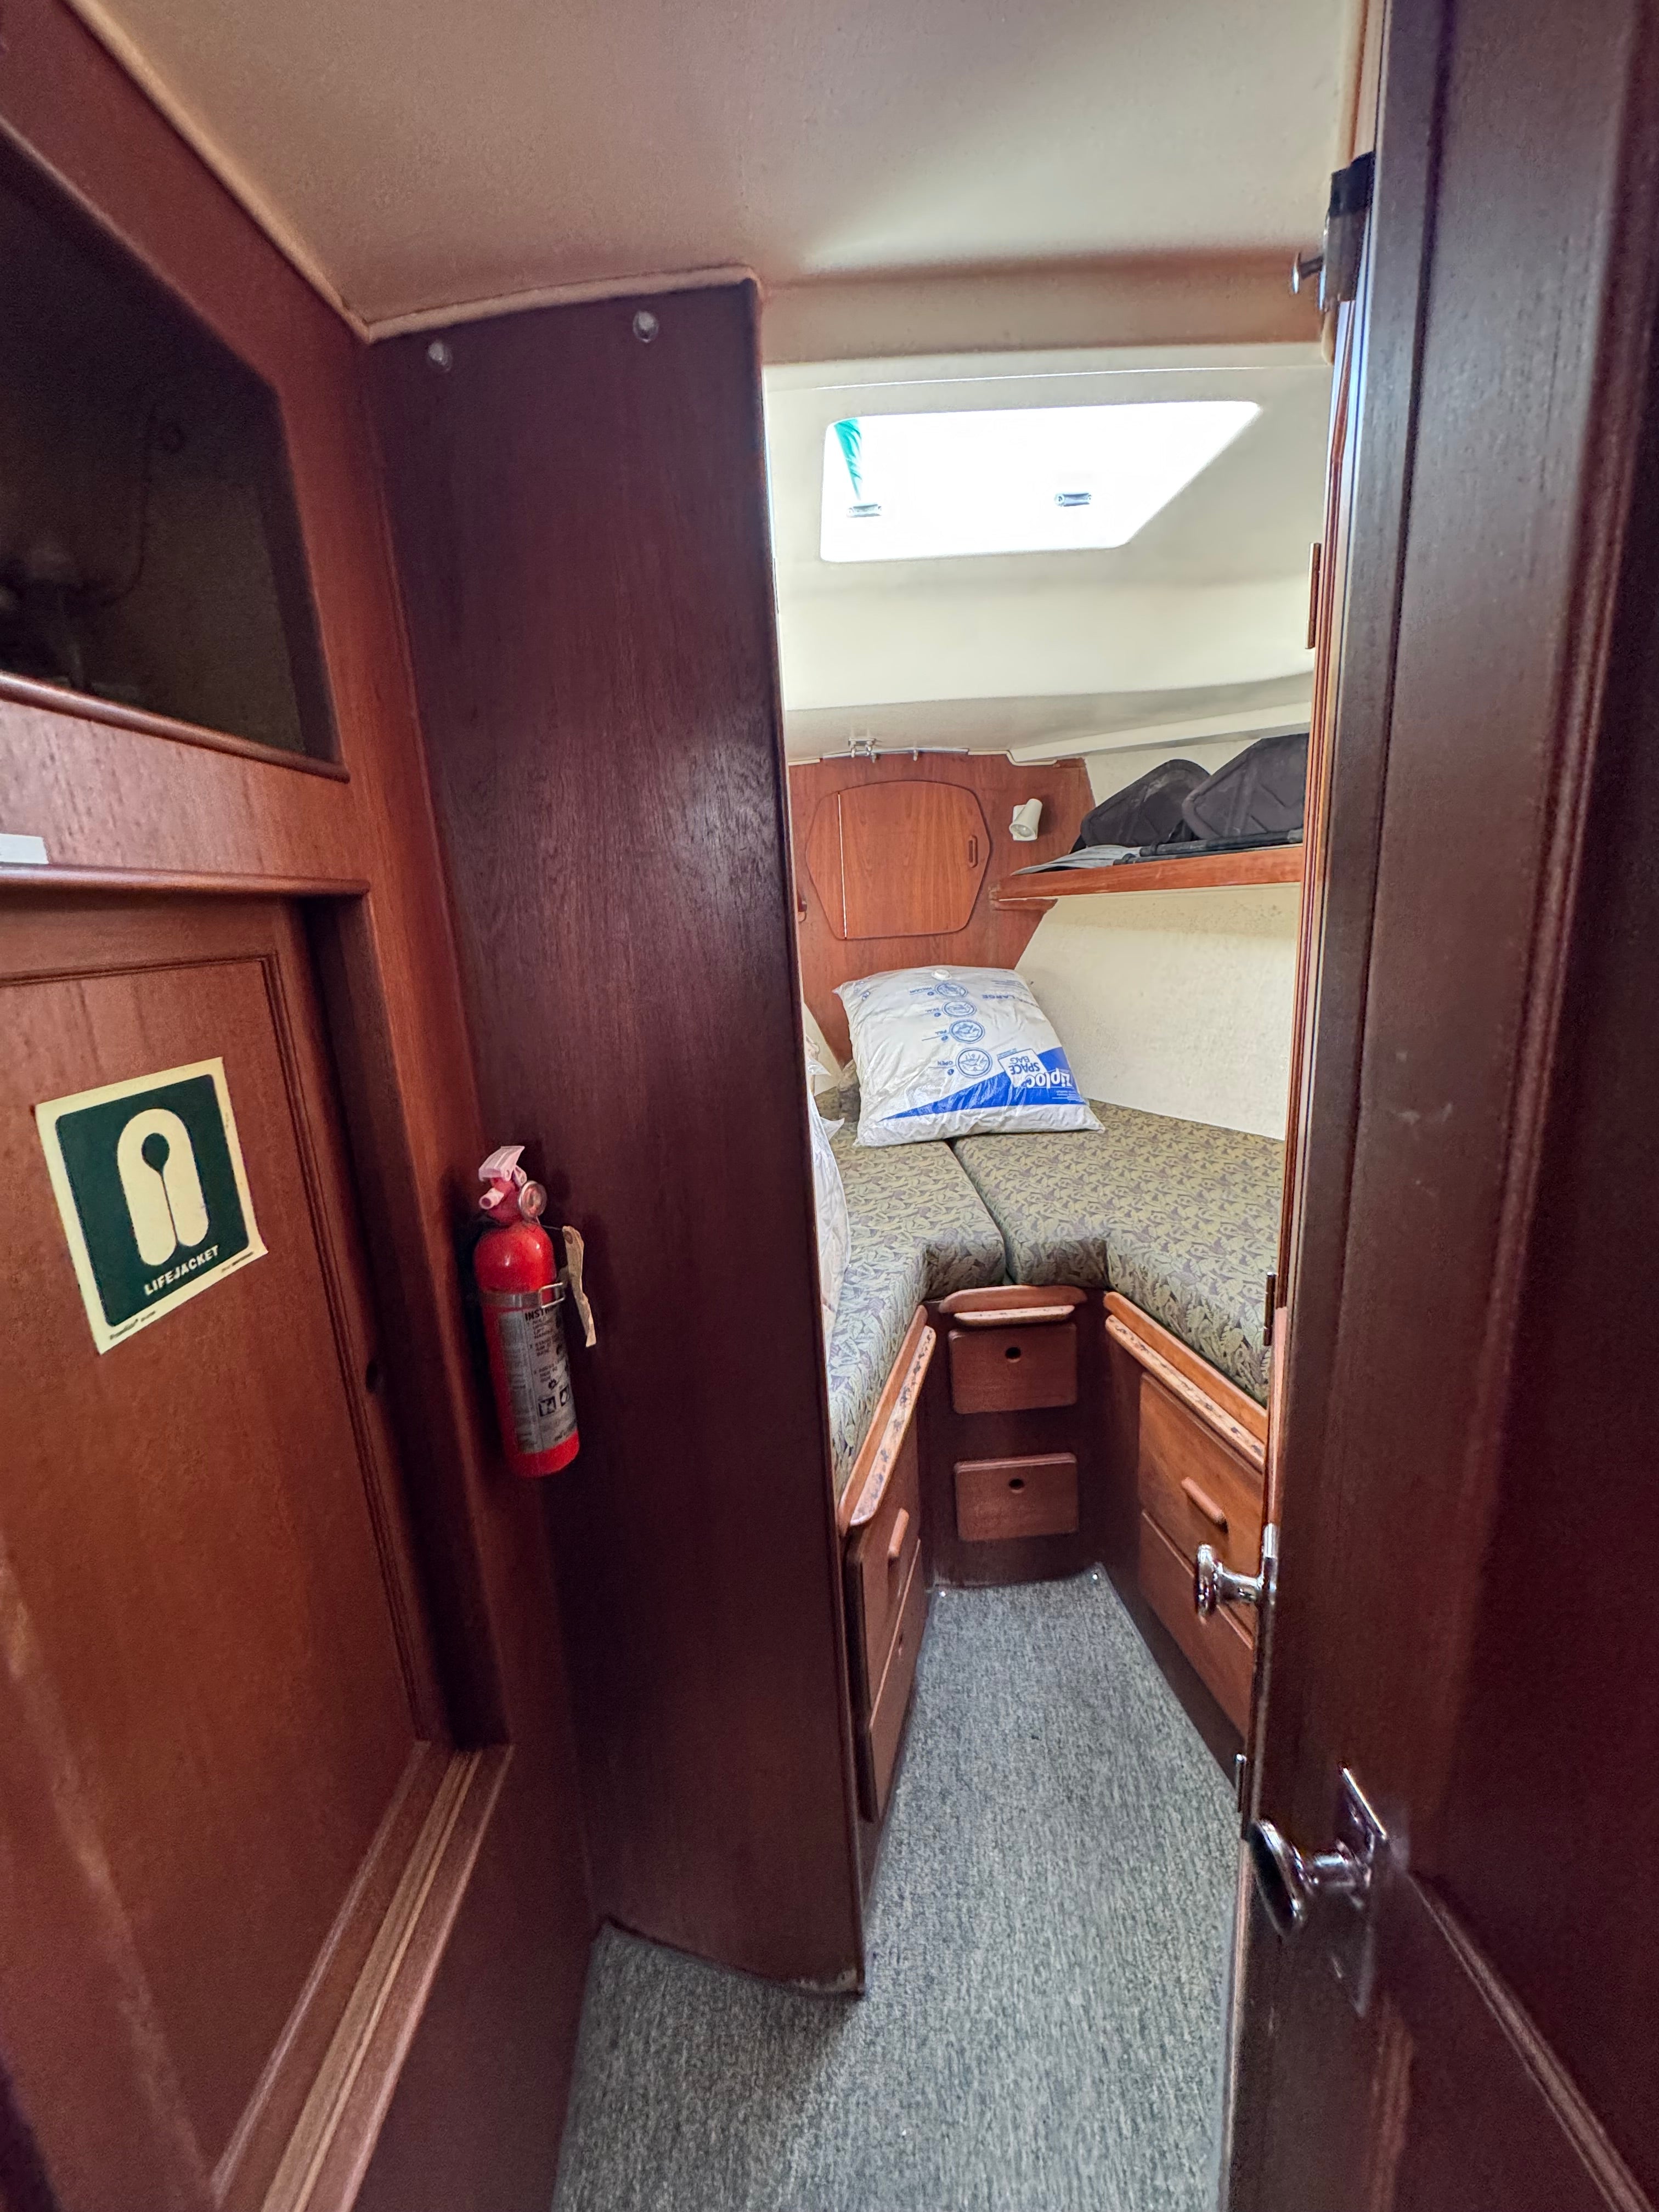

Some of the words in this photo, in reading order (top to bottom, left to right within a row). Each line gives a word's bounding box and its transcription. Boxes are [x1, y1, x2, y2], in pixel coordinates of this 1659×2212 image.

[1010, 1056, 1030, 1064] BAG
[1008, 1062, 1041, 1075] SPACE
[144, 1245, 219, 1296] LIFEJACKET
